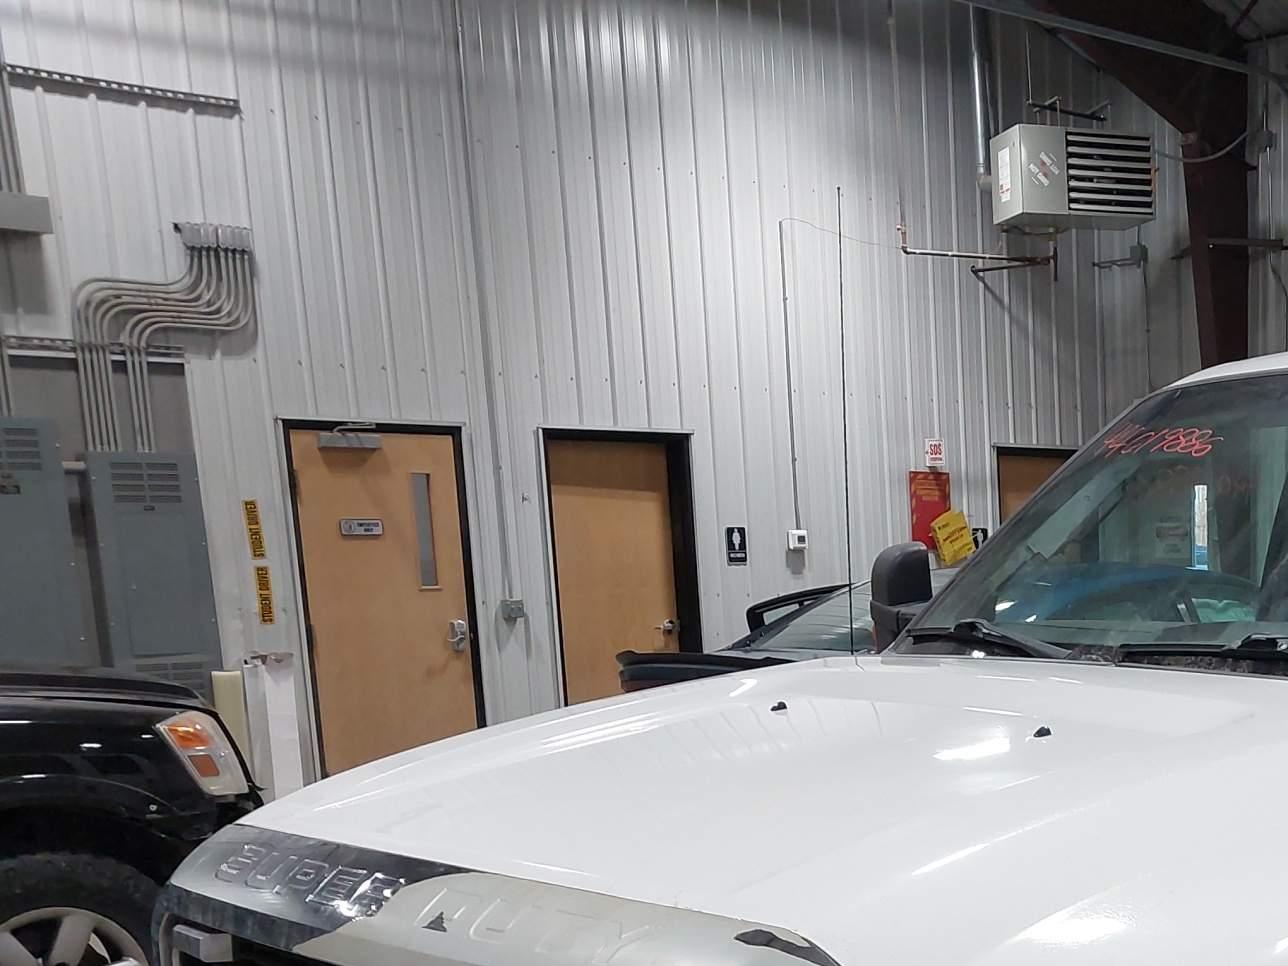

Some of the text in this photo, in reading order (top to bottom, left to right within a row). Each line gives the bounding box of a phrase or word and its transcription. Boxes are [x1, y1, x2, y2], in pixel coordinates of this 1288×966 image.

[244, 500, 265, 557] STUDENT DRIVER
[256, 567, 273, 623] STUDENT DRIVER
[213, 843, 406, 920] SUPER
